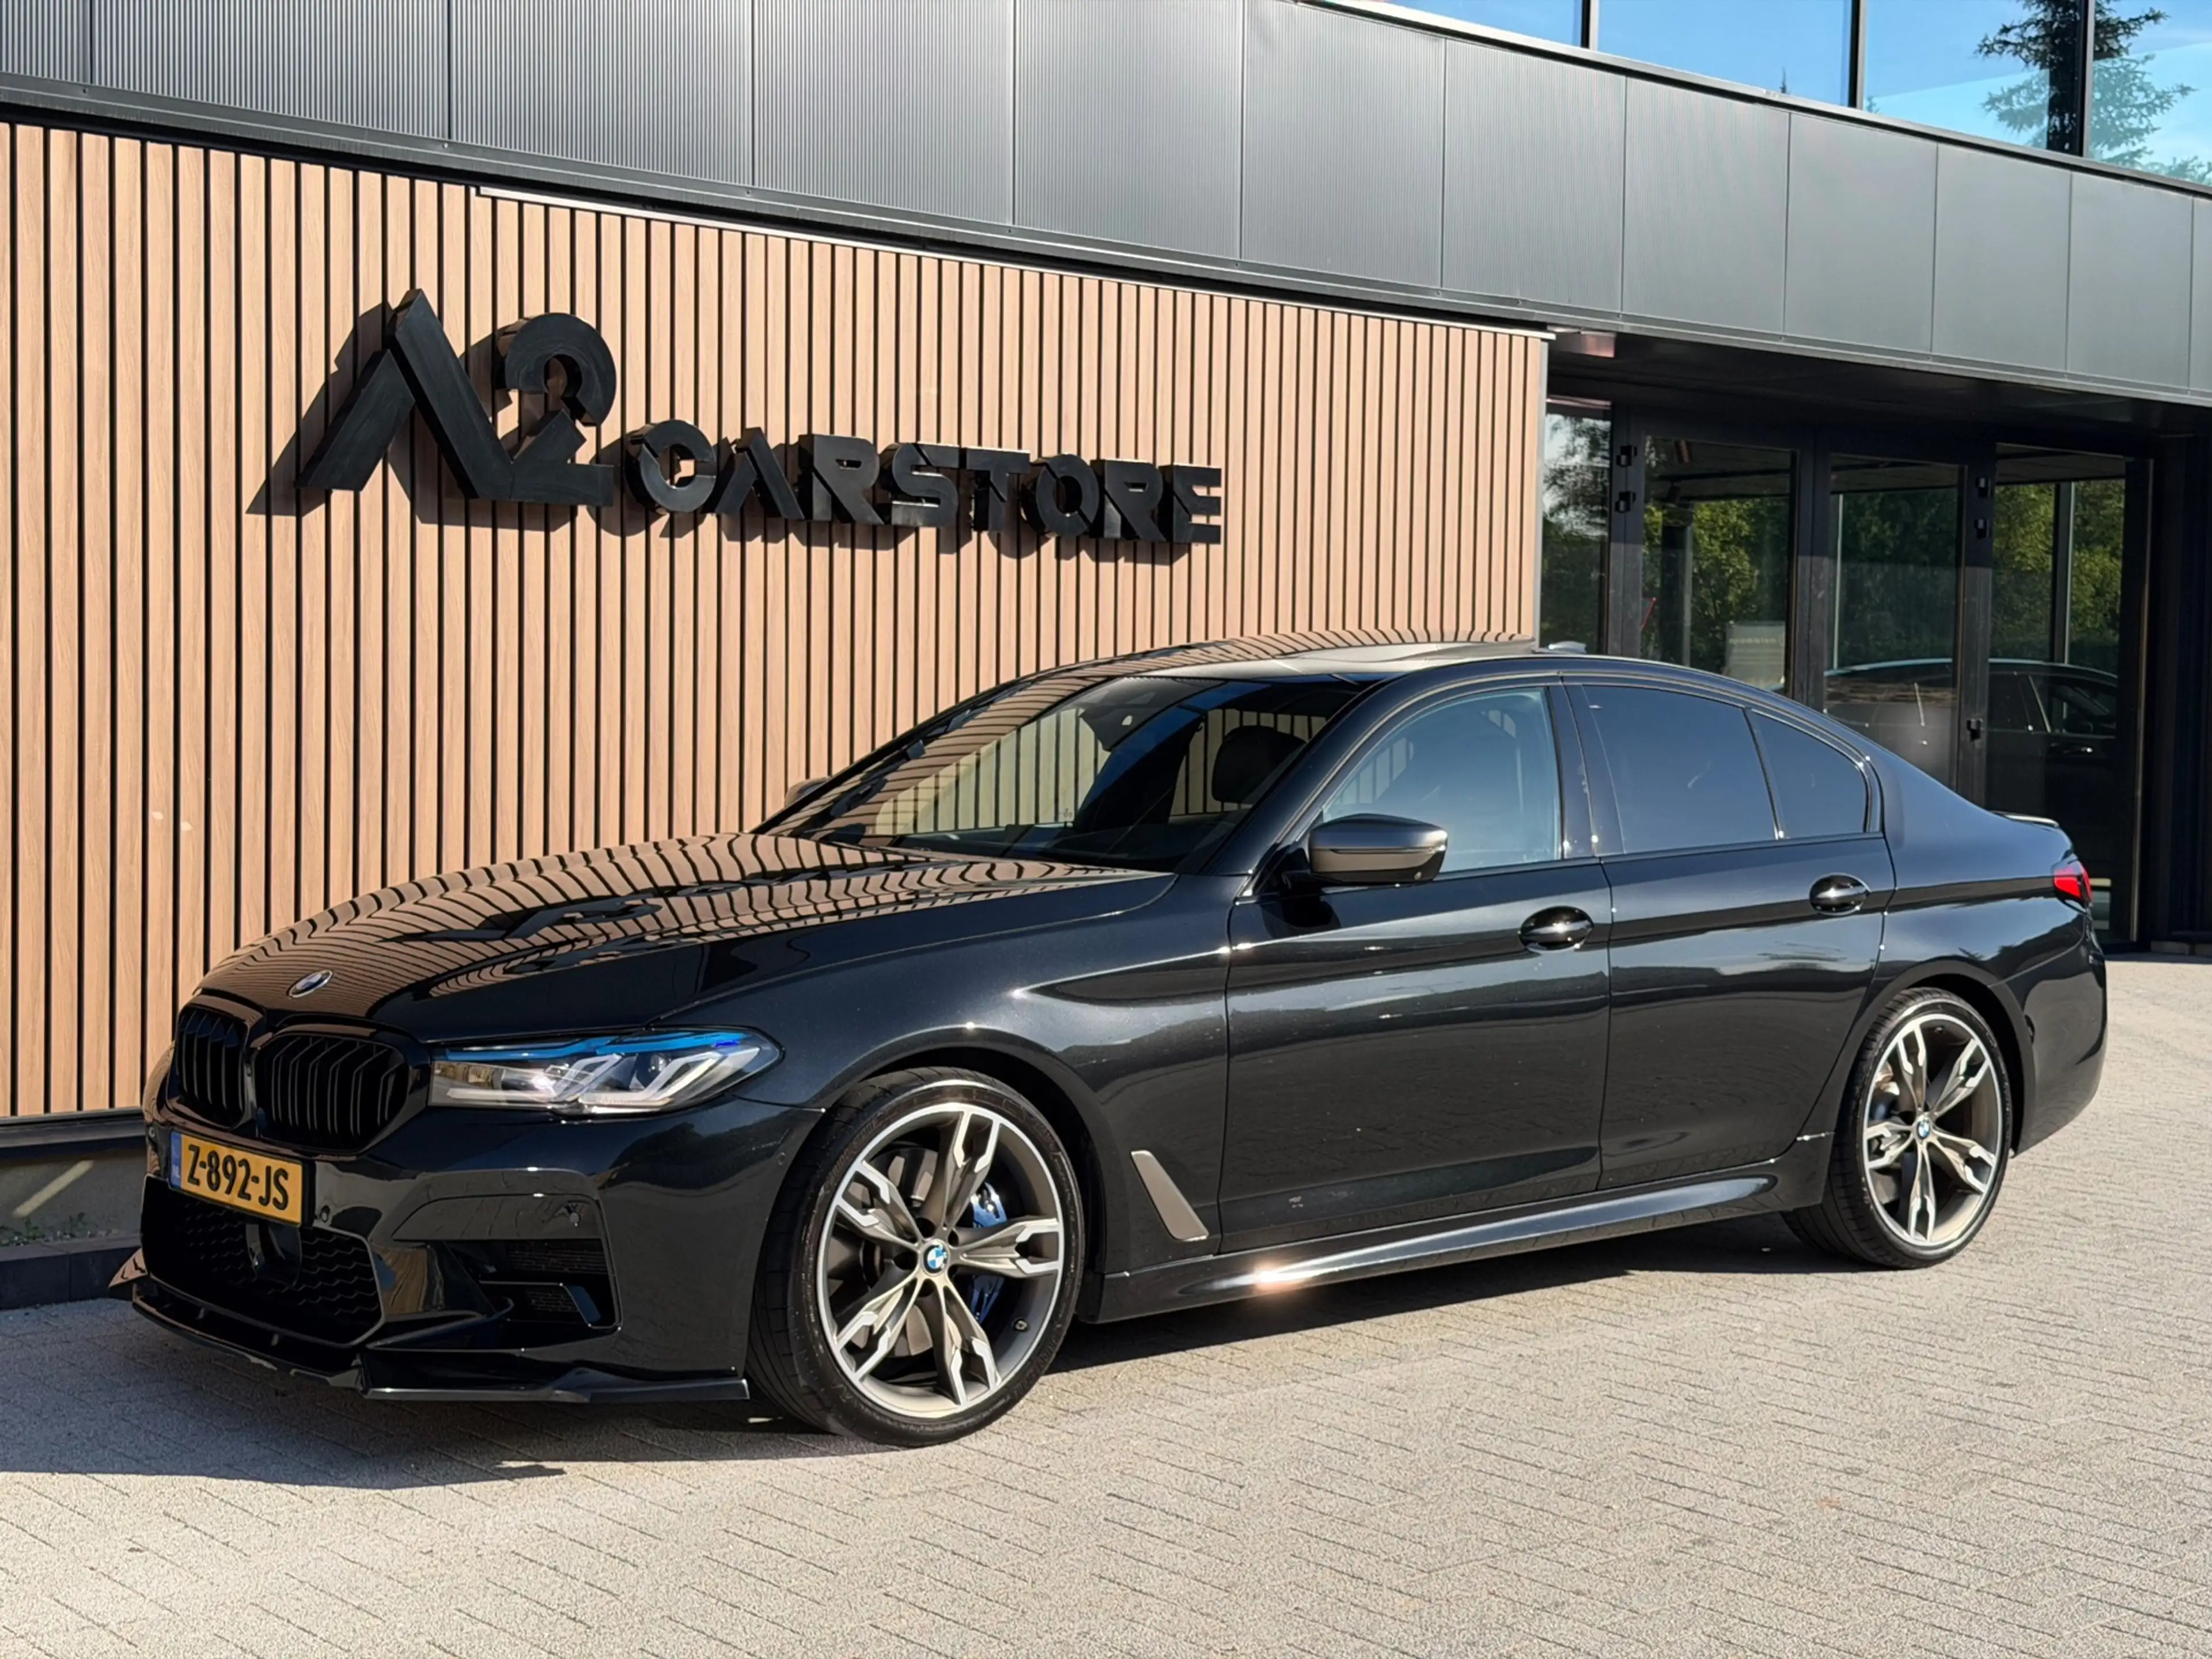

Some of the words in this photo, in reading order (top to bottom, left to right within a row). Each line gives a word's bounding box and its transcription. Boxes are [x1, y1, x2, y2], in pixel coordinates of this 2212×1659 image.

[294, 288, 614, 507] A2
[624, 419, 1222, 544] CARSTORE
[187, 1143, 289, 1211] Z-892-JS
